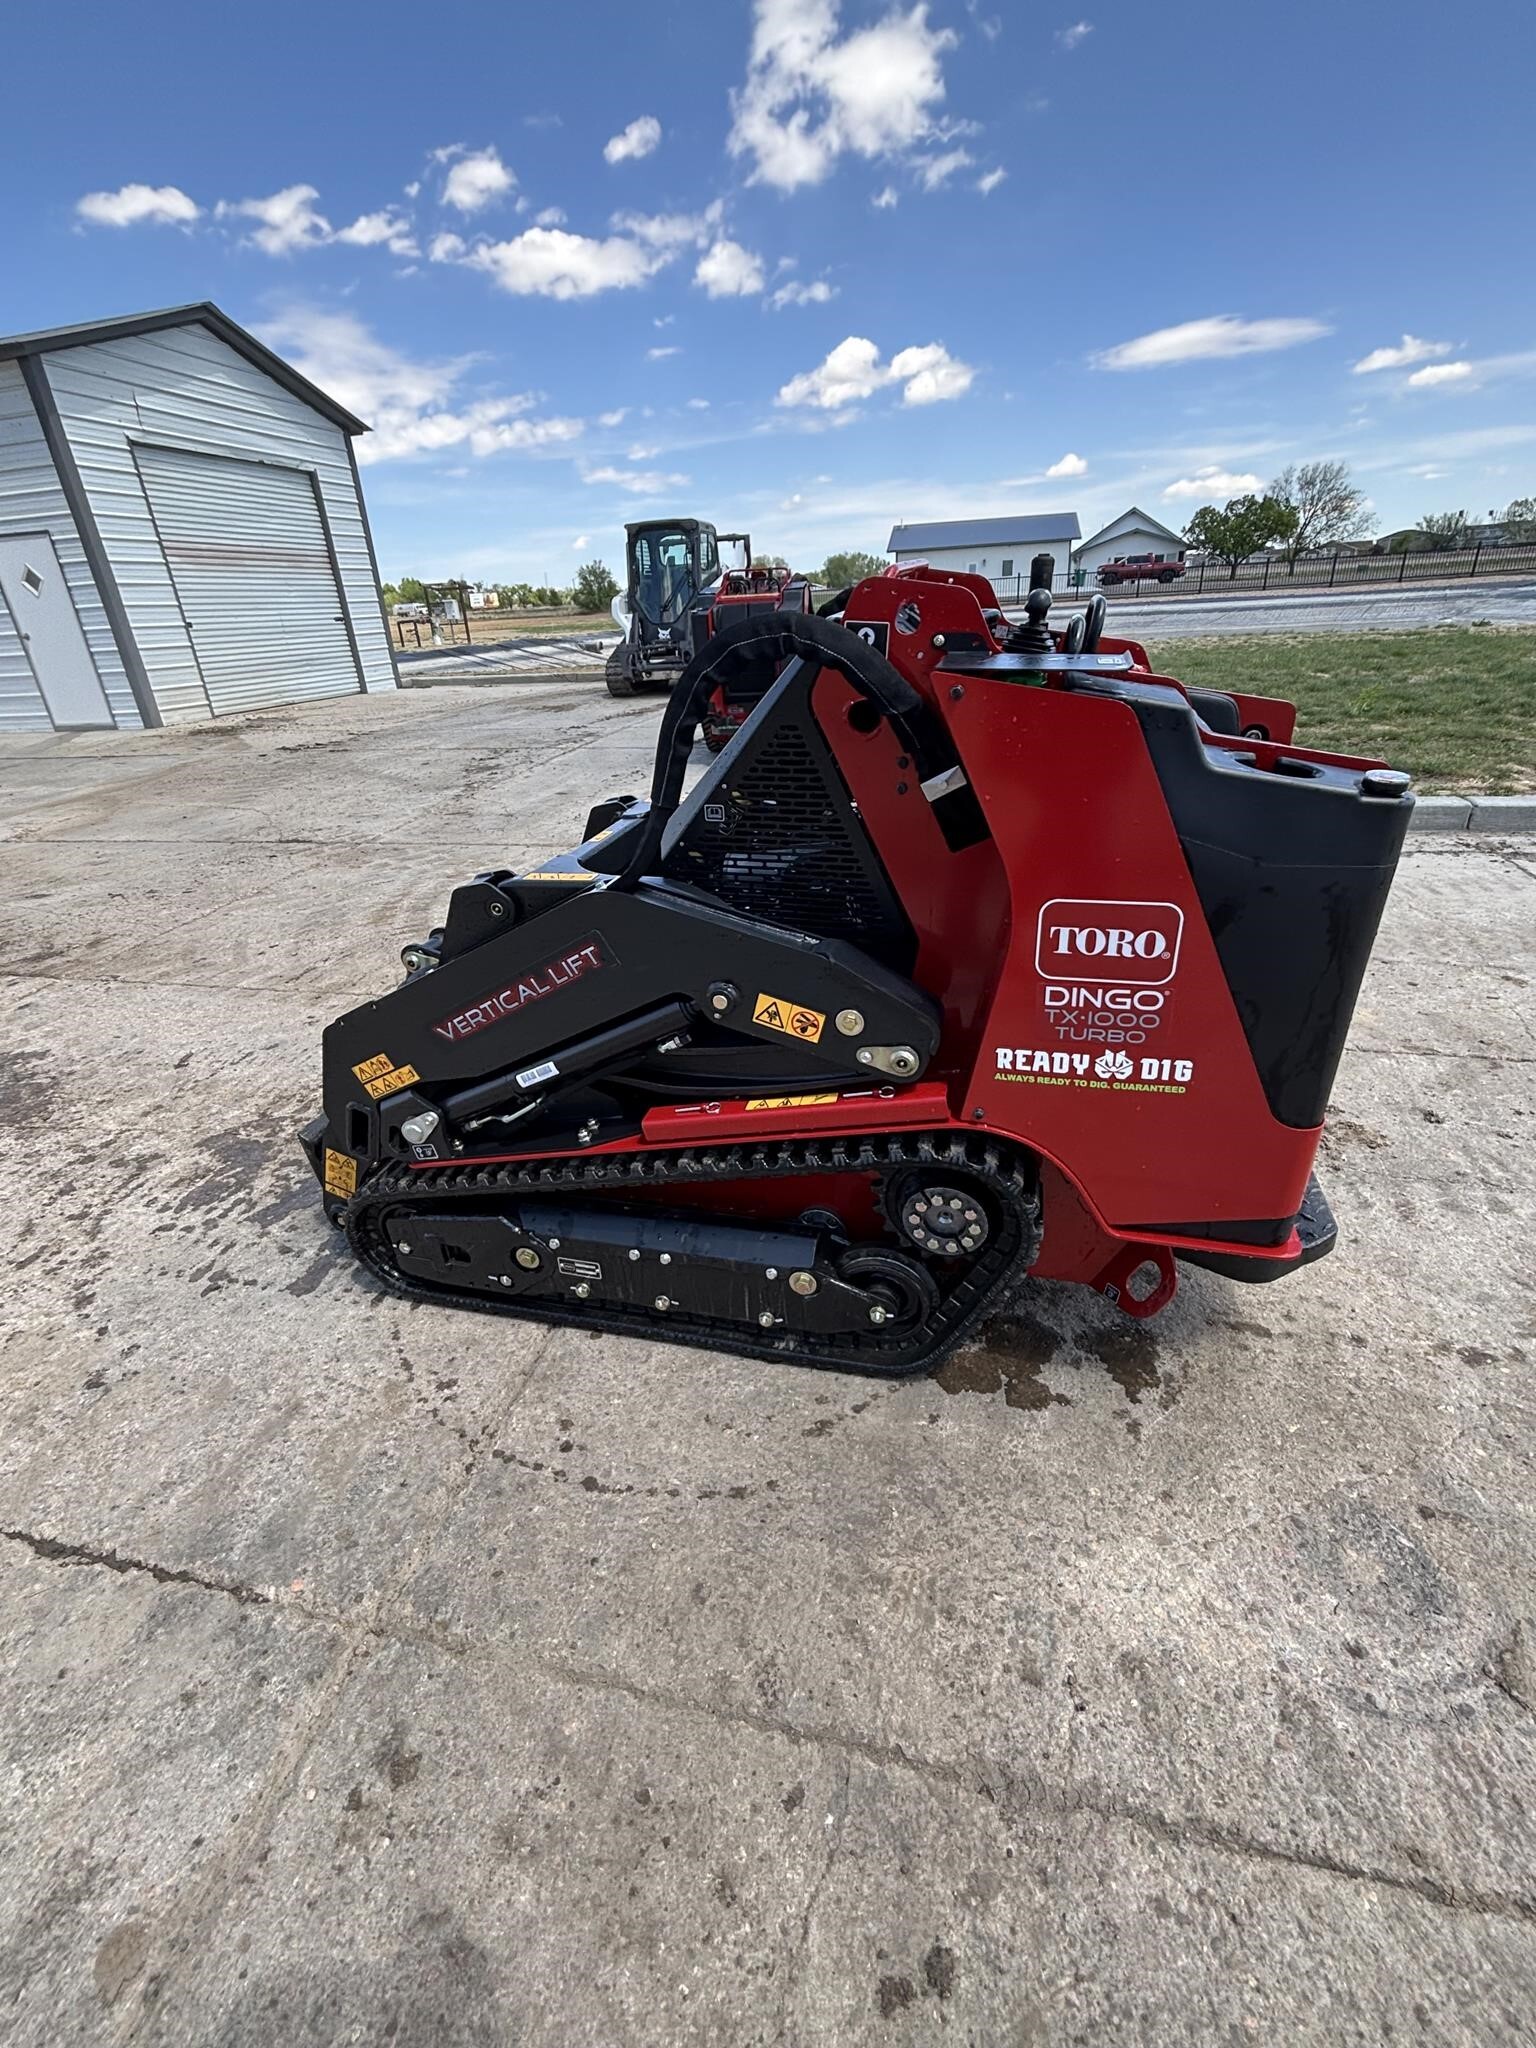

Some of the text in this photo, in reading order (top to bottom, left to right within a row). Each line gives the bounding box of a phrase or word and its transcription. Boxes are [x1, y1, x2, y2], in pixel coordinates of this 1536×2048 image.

[436, 945, 599, 1040] VERTICAL LIFT
[1044, 986, 1165, 1011] DINGO
[1055, 1026, 1146, 1044] TURBO
[995, 1047, 1194, 1083] READY DIG
[994, 1072, 1187, 1094] ALWAYS READY TO DIG. GUARANTEED
